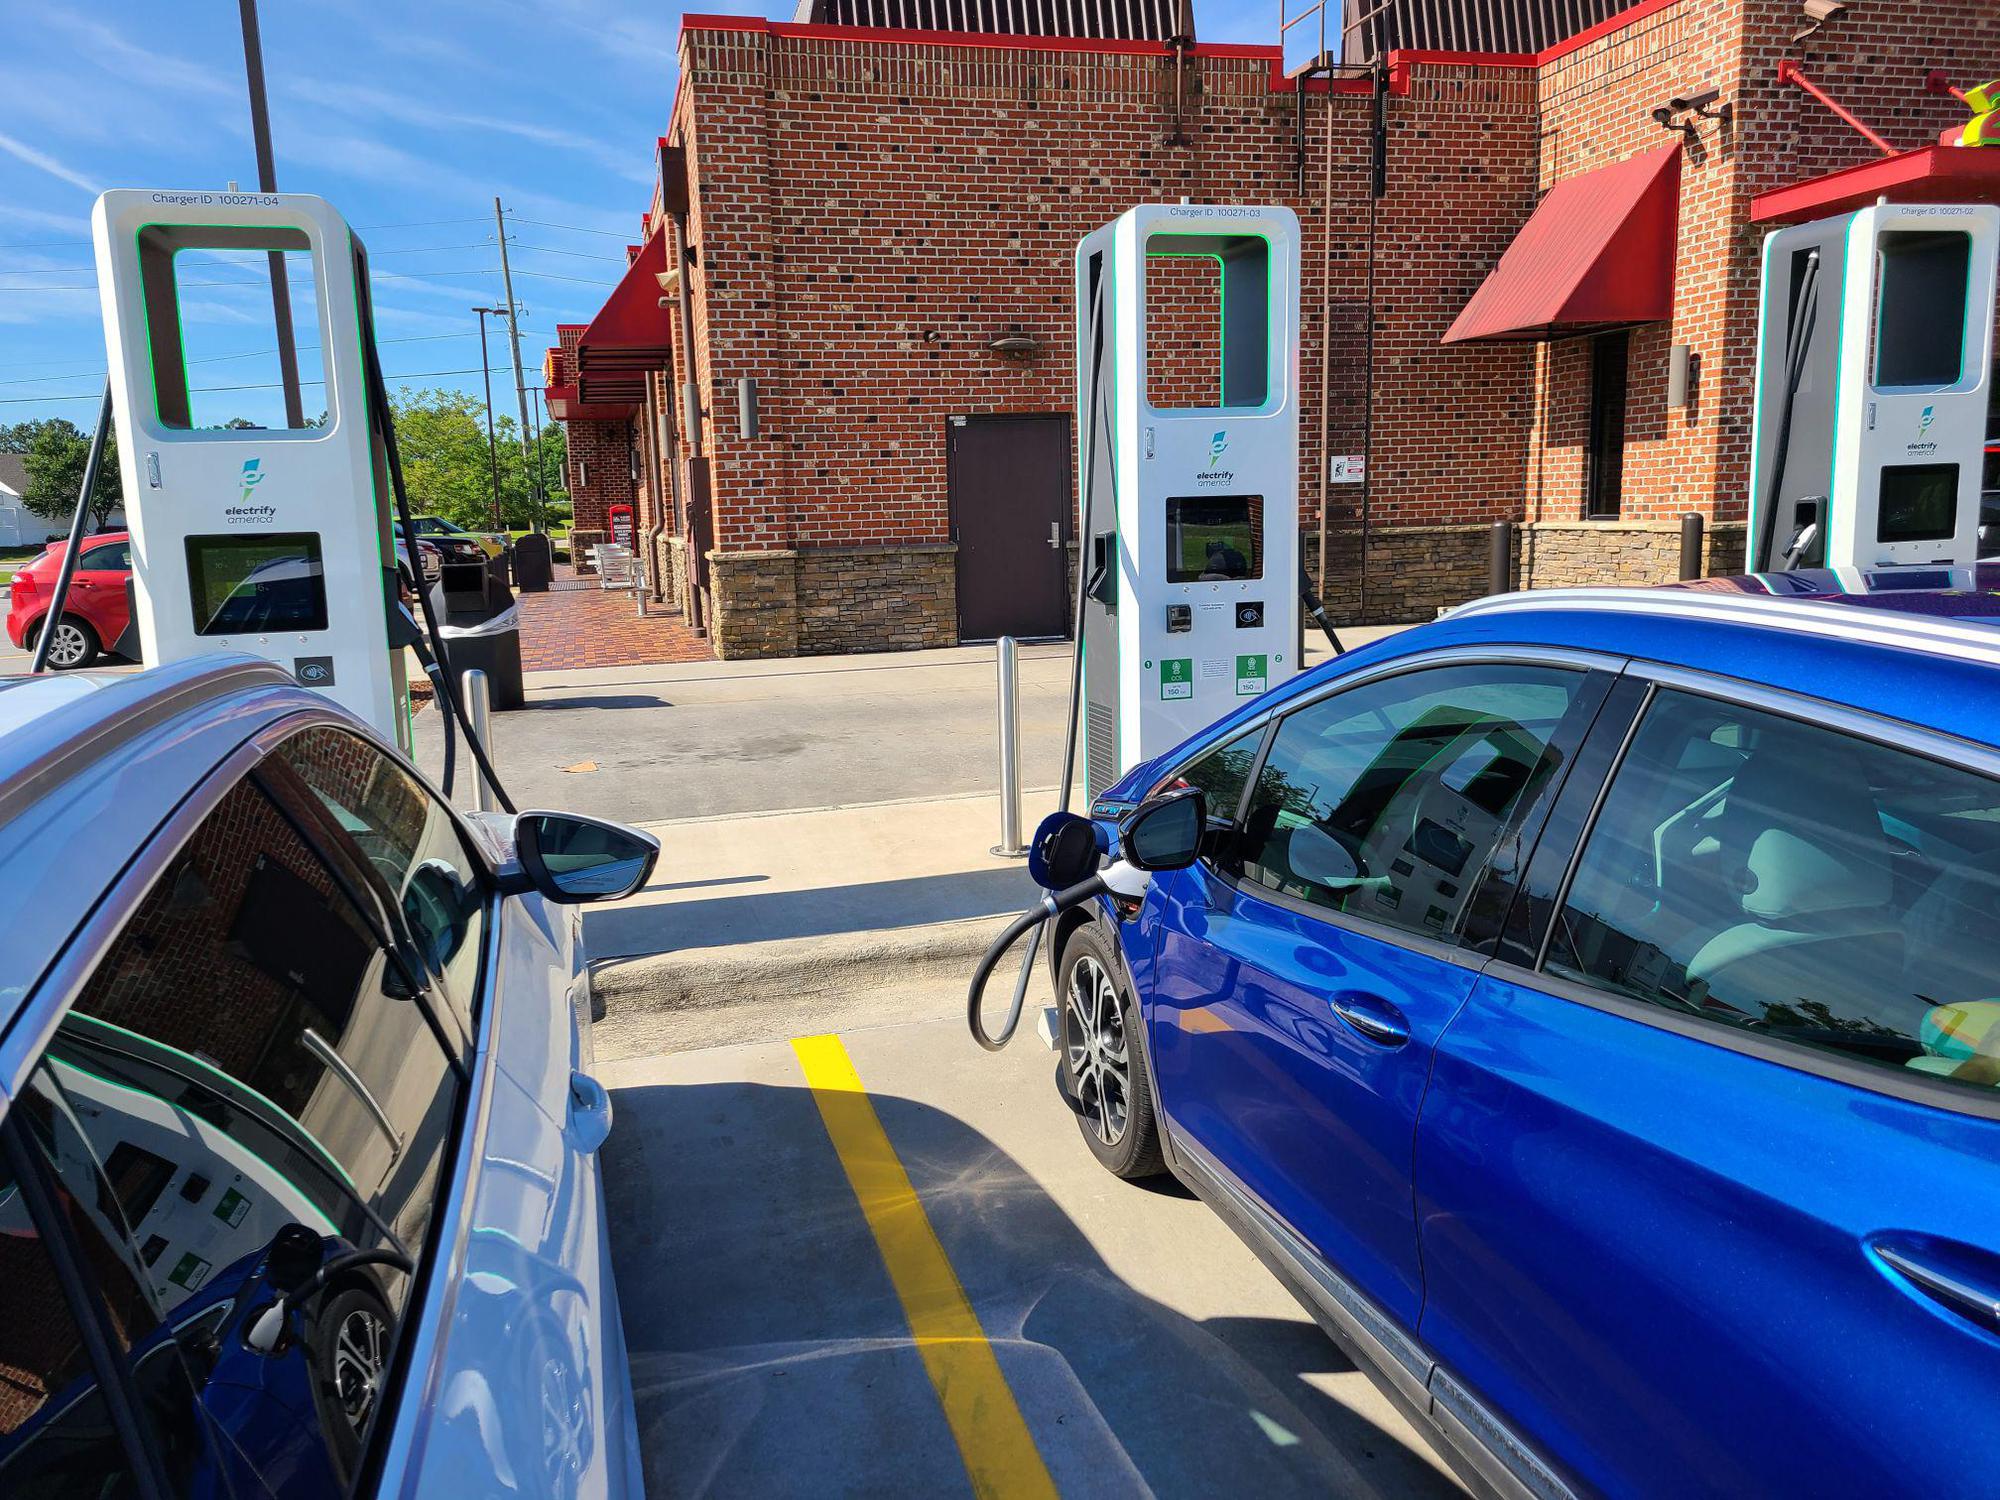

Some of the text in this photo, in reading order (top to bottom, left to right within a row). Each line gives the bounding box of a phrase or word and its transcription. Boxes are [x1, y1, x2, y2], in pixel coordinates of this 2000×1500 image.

[152, 193, 279, 206] Charger ID 100271-04
[1170, 207, 1261, 218] Charger ID 100271-03
[1901, 207, 1928, 217] Charger
[1907, 442, 1938, 450] electrify
[1196, 471, 1234, 480] electrify
[225, 505, 276, 517] electrify
[227, 516, 273, 524] america
